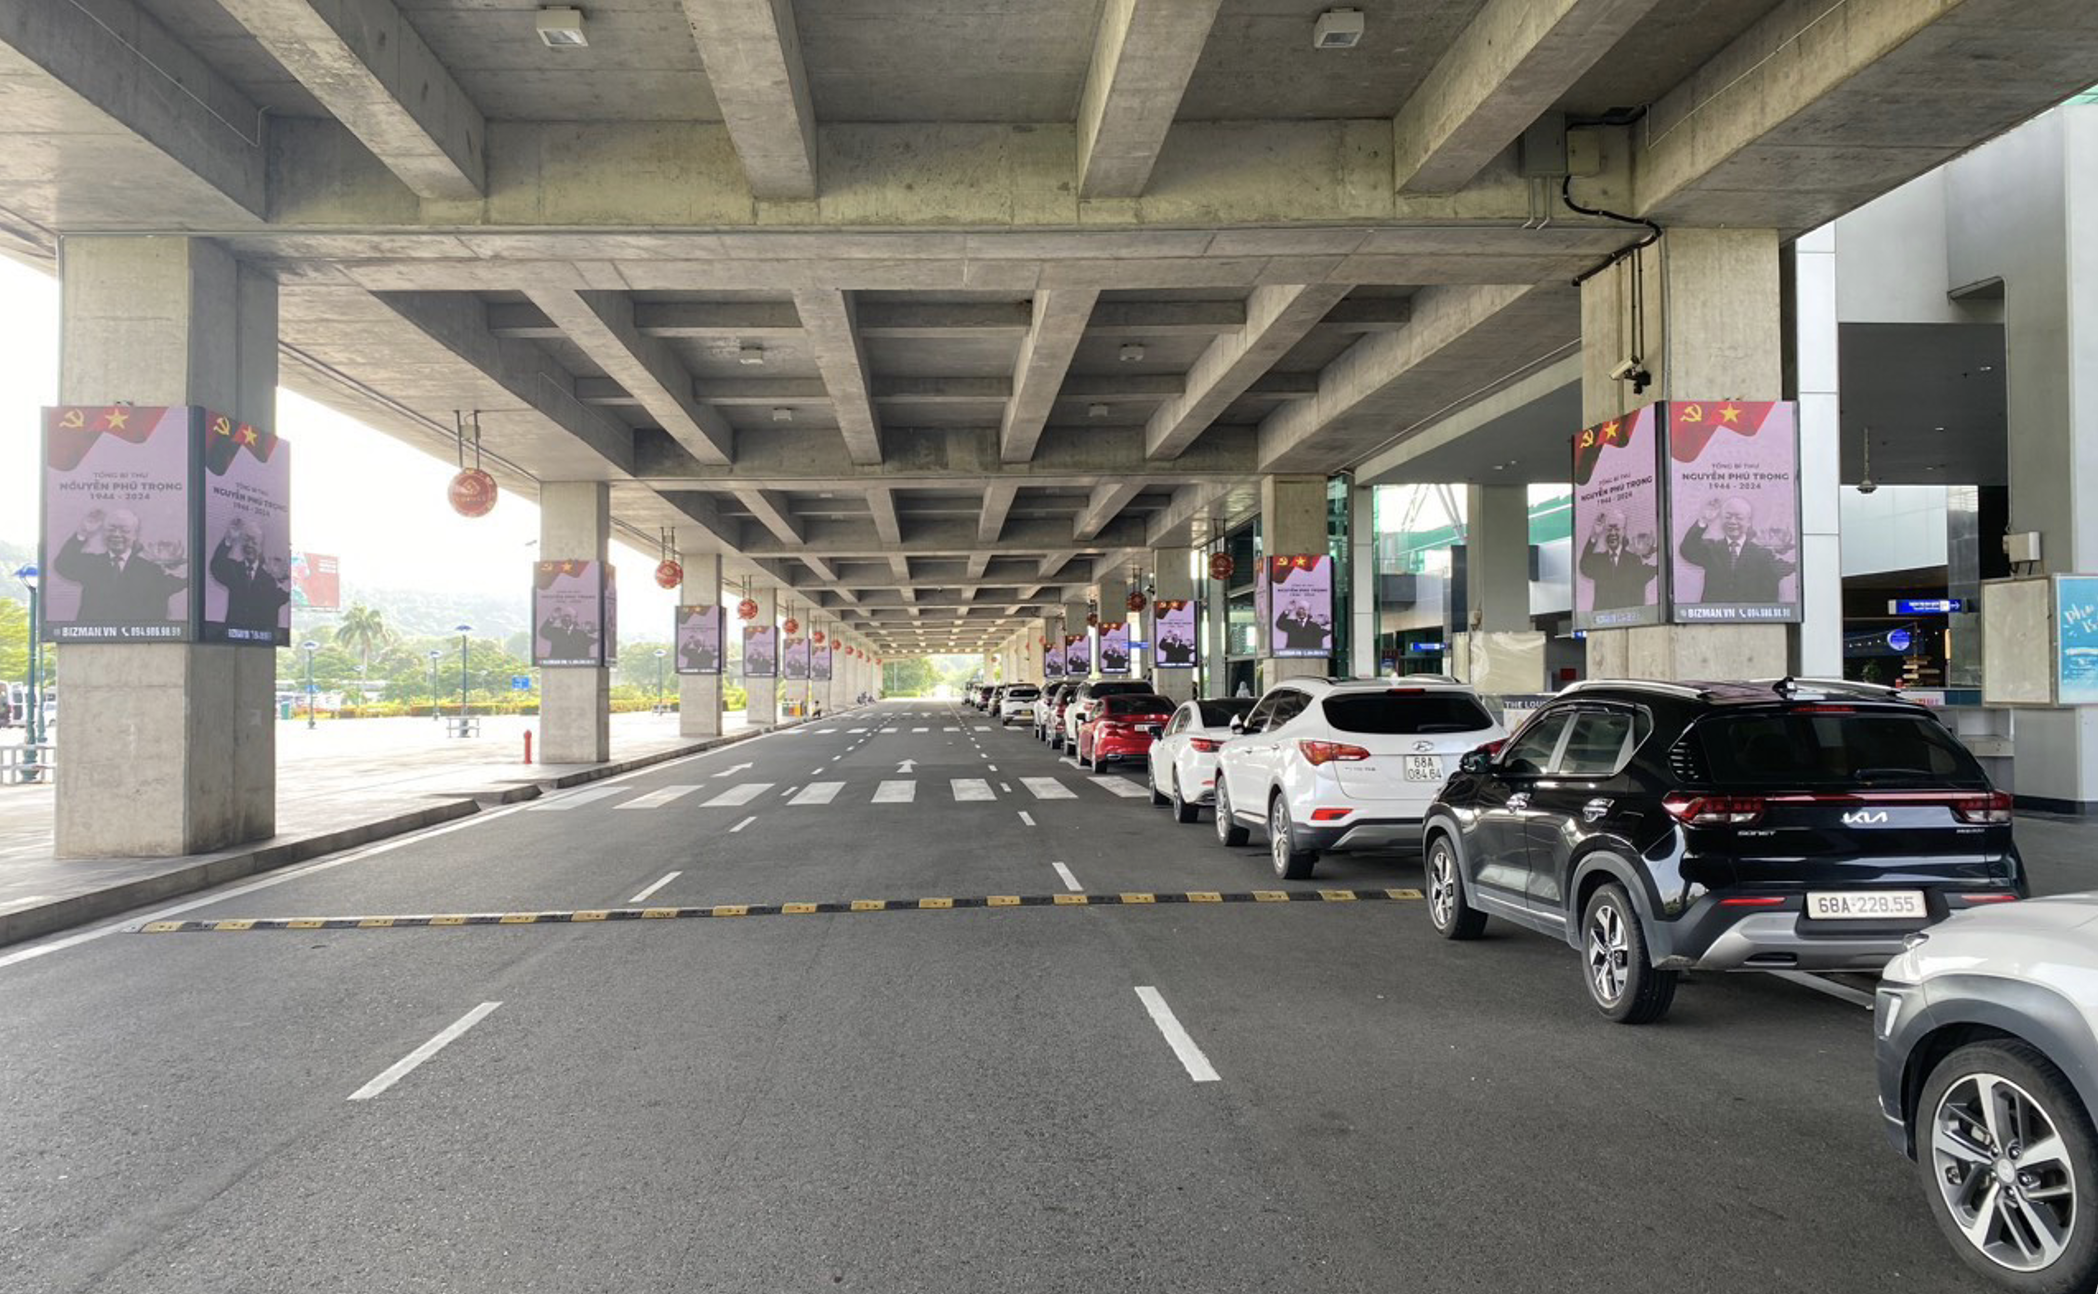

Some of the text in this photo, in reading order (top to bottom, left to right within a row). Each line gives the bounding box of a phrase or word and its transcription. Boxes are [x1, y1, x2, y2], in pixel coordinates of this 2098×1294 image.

[1682, 470, 1725, 480] NGUYỄN
[1753, 472, 1789, 482] TRỌNG
[60, 479, 110, 491] NGUYỄN
[141, 482, 183, 492] TRỌNG
[1504, 700, 1524, 709] THE
[1414, 756, 1434, 768] 68A
